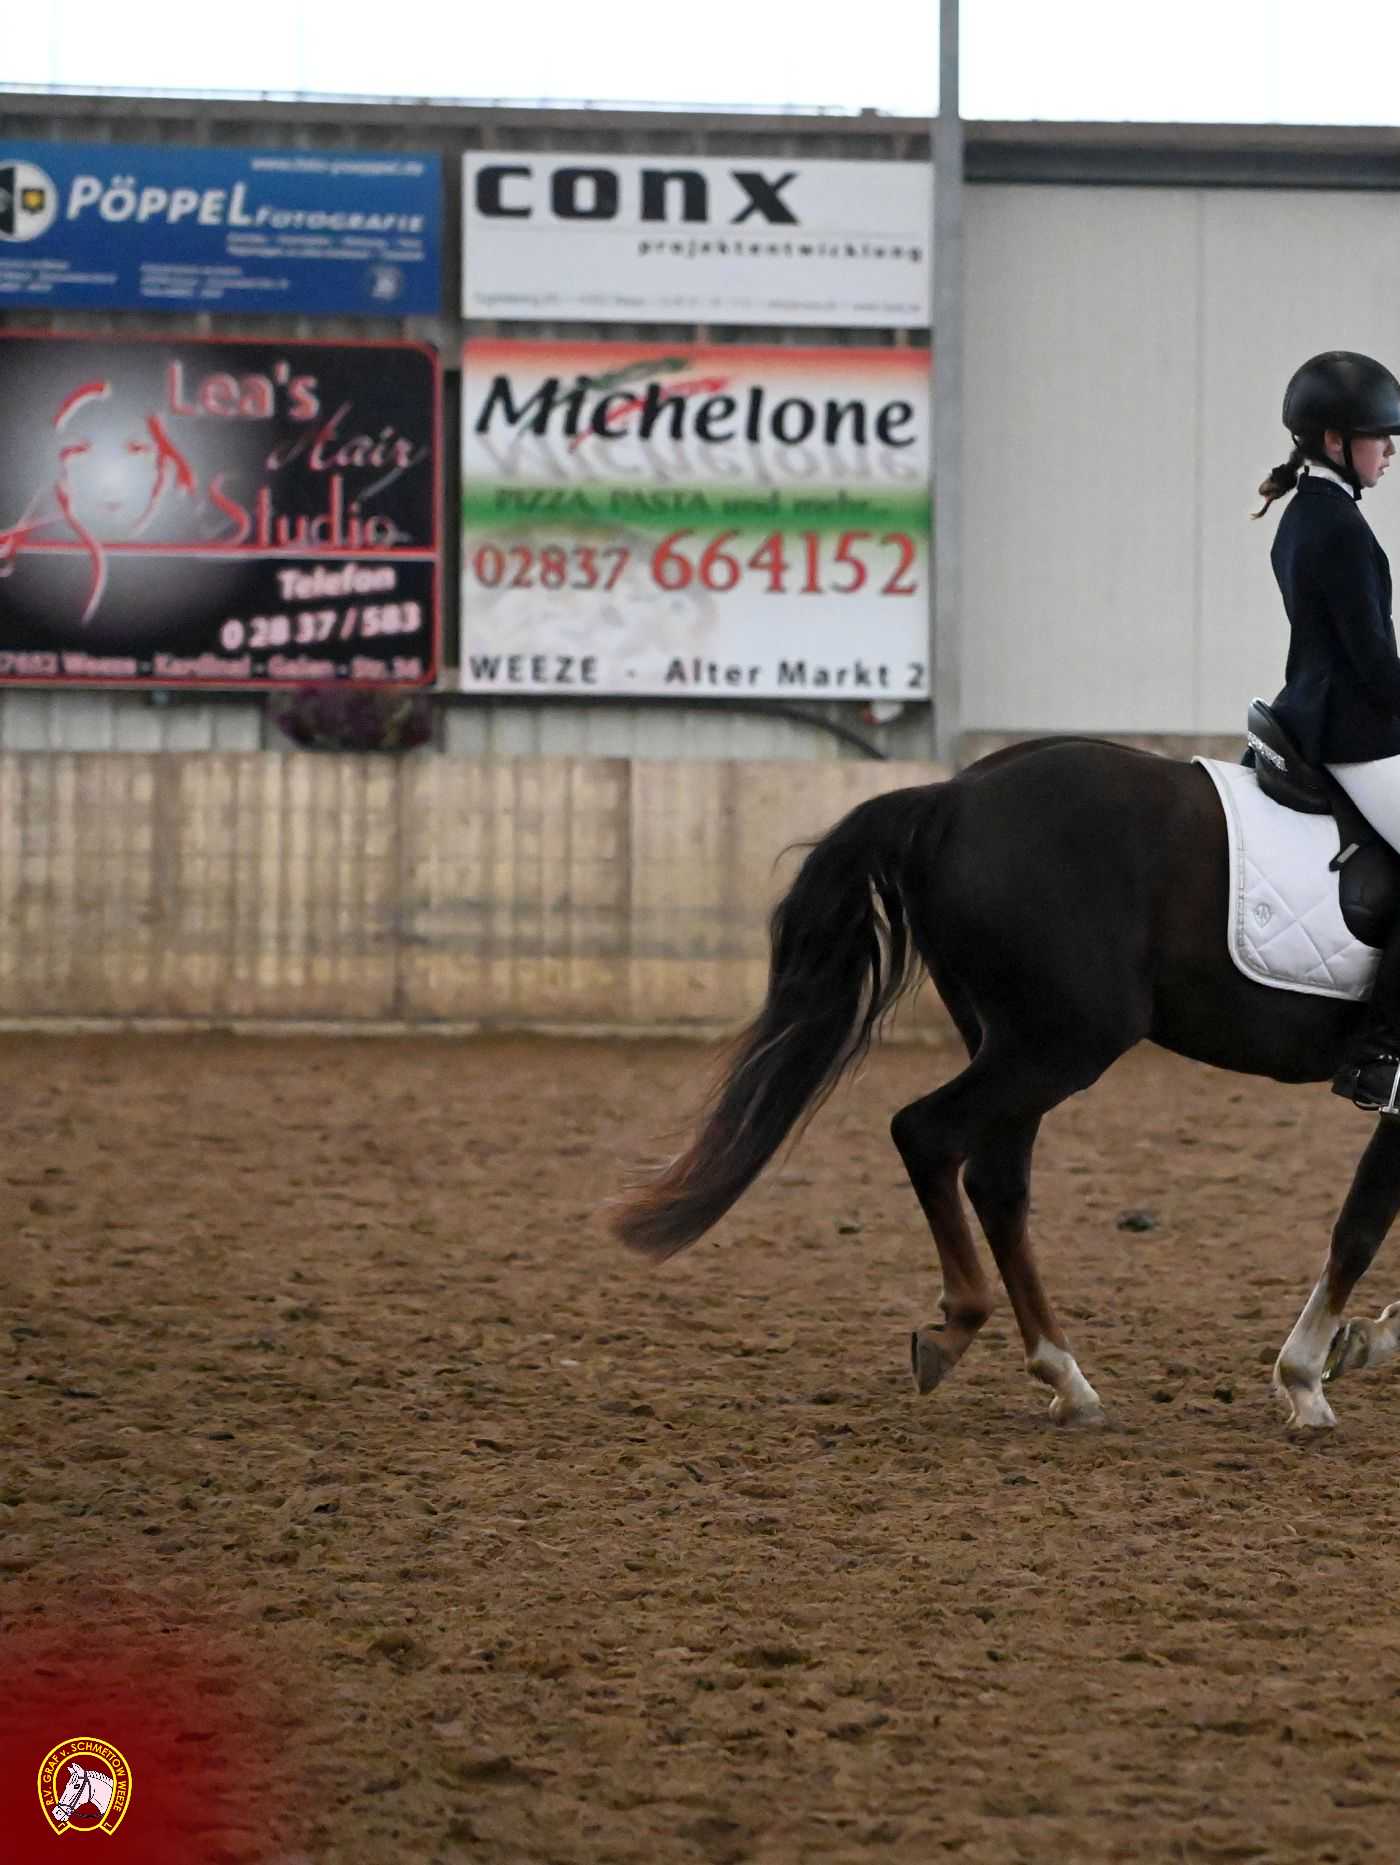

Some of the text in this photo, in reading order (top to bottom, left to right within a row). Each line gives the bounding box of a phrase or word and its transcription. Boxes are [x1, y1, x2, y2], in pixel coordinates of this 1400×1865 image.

[66, 174, 425, 233] PÖPPEL FOTOGRAFIE
[474, 164, 801, 226] conx
[638, 239, 924, 263] projektentwicklung
[167, 359, 321, 420] Lea's
[474, 374, 917, 449] Michelone
[198, 473, 412, 549] Studio
[278, 562, 397, 601] Telefon
[472, 529, 918, 597] 02837 664152
[470, 654, 599, 686] WEEZE
[664, 659, 762, 686] Alter
[776, 660, 890, 688] Markt
[906, 662, 926, 688] 2
